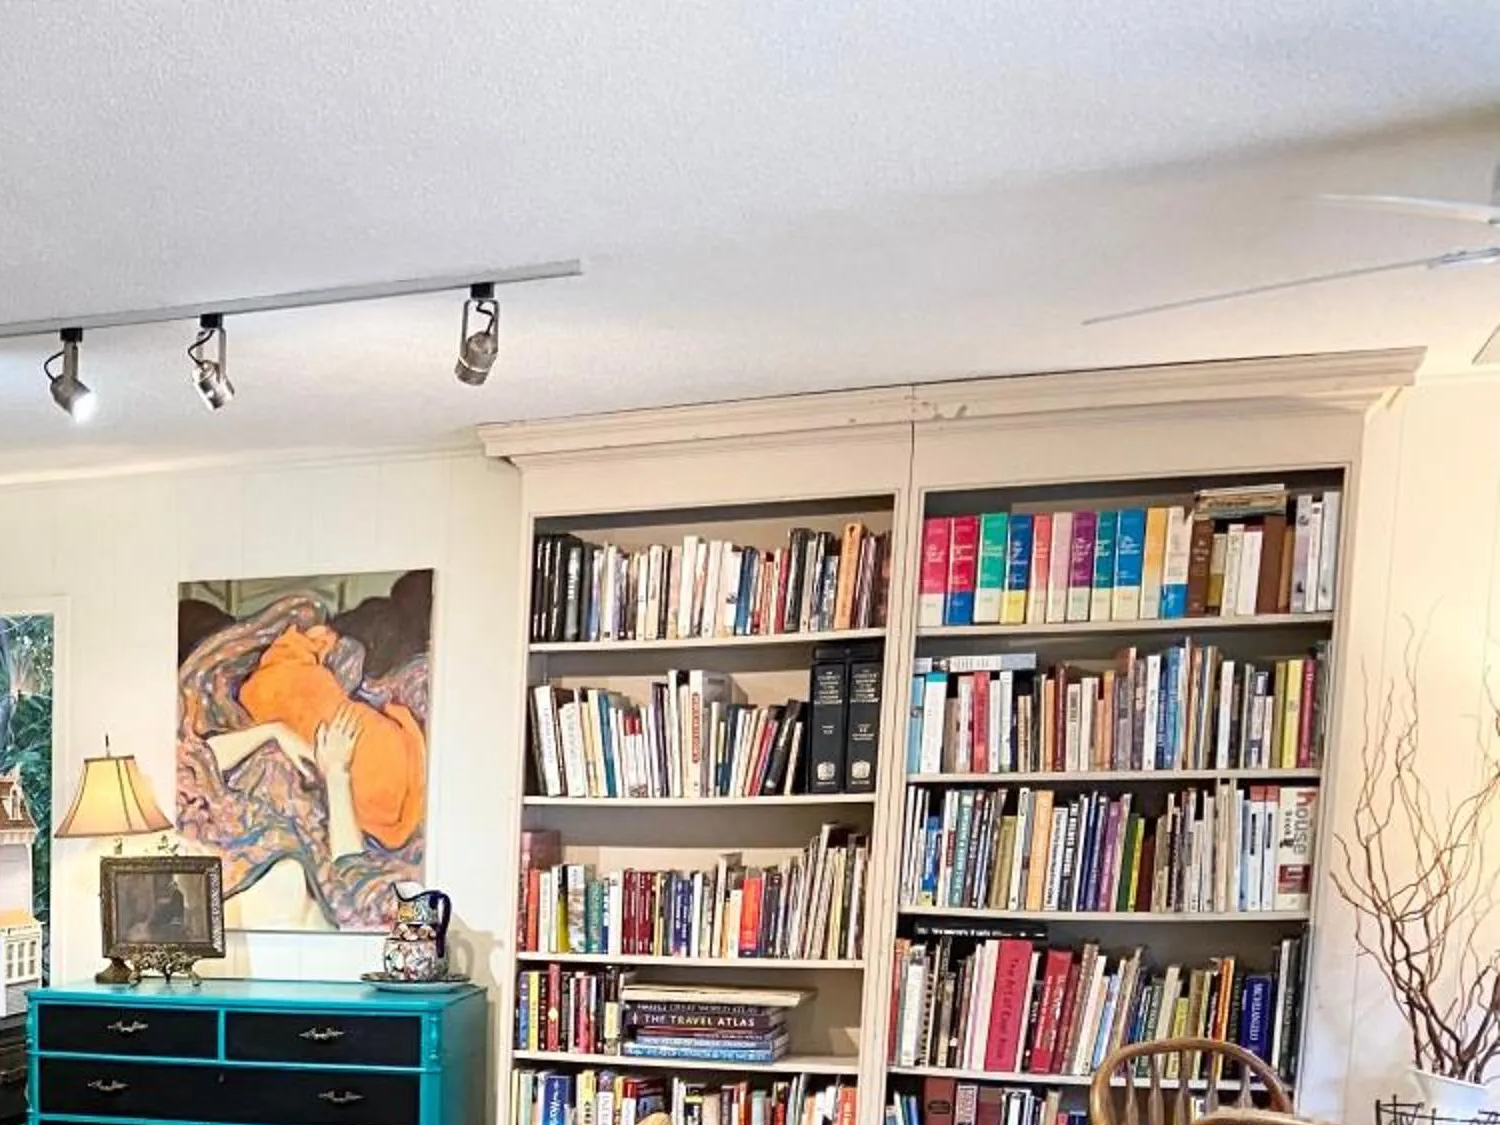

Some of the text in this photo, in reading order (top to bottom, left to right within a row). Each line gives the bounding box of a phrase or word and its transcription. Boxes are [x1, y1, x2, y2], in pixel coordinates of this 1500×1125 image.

[1293, 791, 1317, 855] house
[644, 1013, 756, 1028] THE TRAVEL ATLAS
